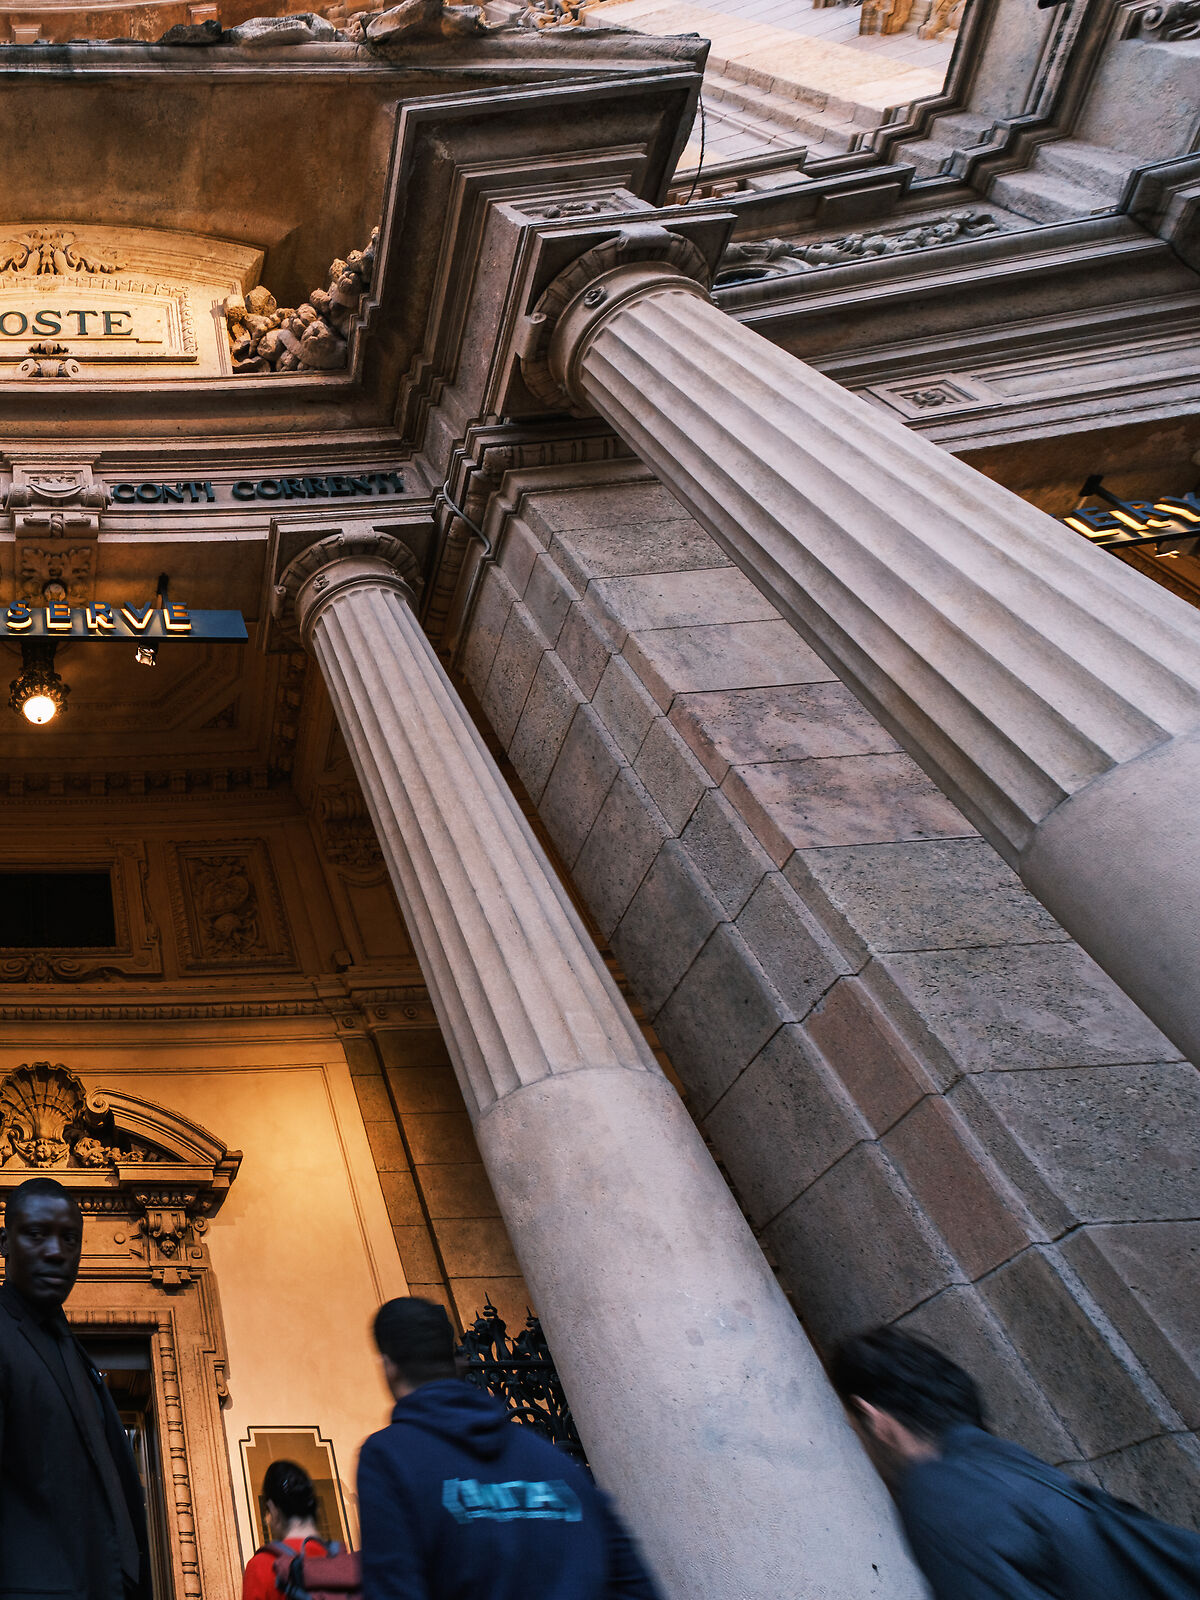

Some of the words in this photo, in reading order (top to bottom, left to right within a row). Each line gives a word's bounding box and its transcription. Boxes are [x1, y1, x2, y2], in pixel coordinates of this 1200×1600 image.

[112, 482, 216, 503] CONTI
[231, 472, 404, 501] CORRENTI
[1050, 492, 1200, 539] ERY
